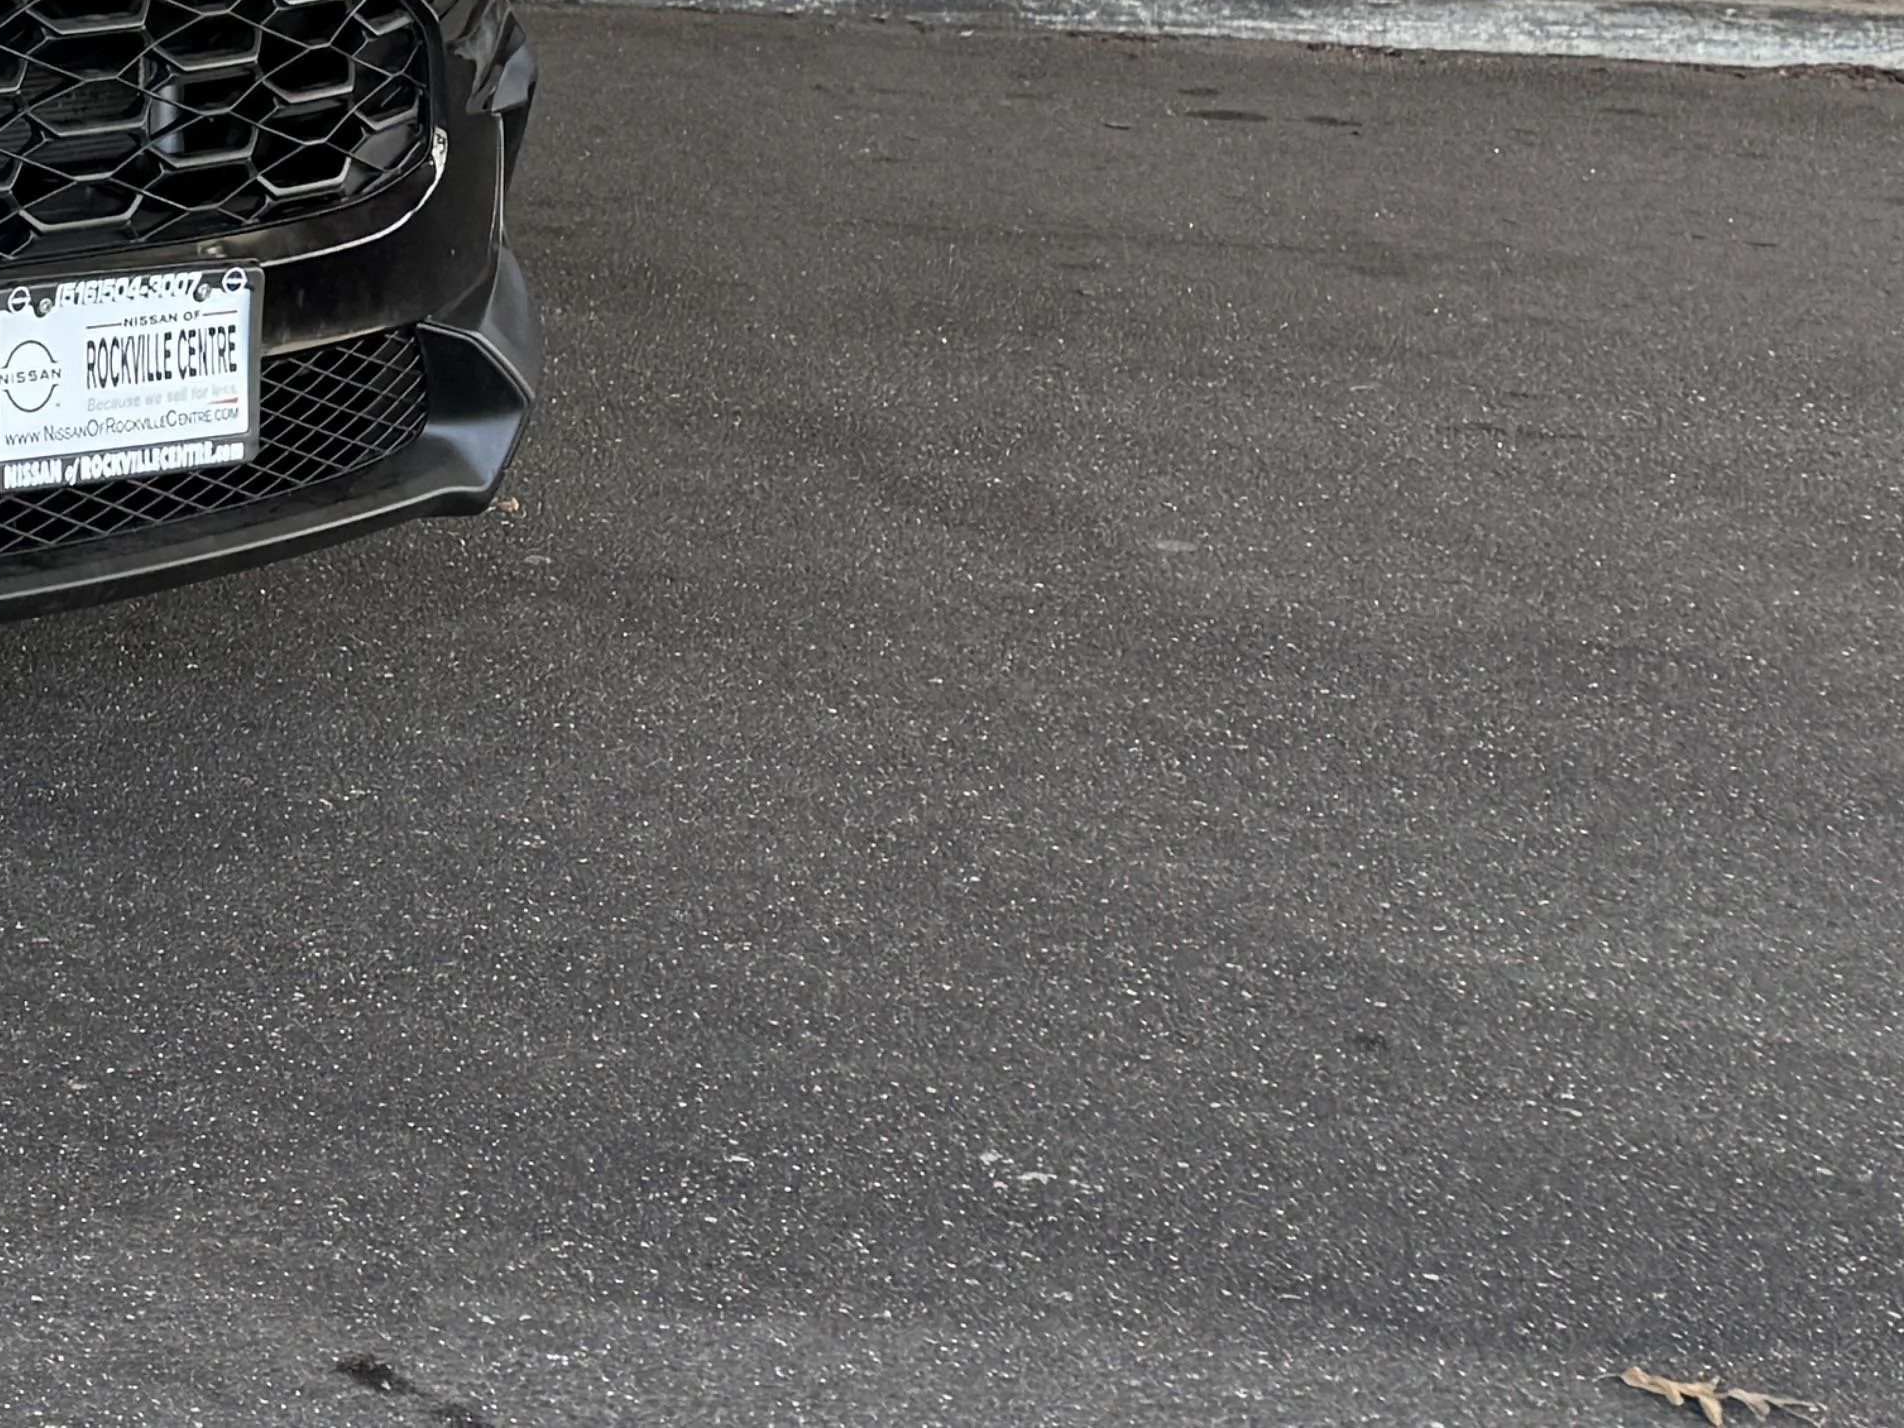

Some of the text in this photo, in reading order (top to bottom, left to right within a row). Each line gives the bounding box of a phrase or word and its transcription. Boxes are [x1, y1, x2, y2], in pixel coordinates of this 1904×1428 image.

[122, 309, 201, 328] NISSAN OF
[86, 324, 238, 390] ROCKVILLE CENTRE
[3, 457, 62, 489] NISSAN
[64, 457, 80, 486] of
